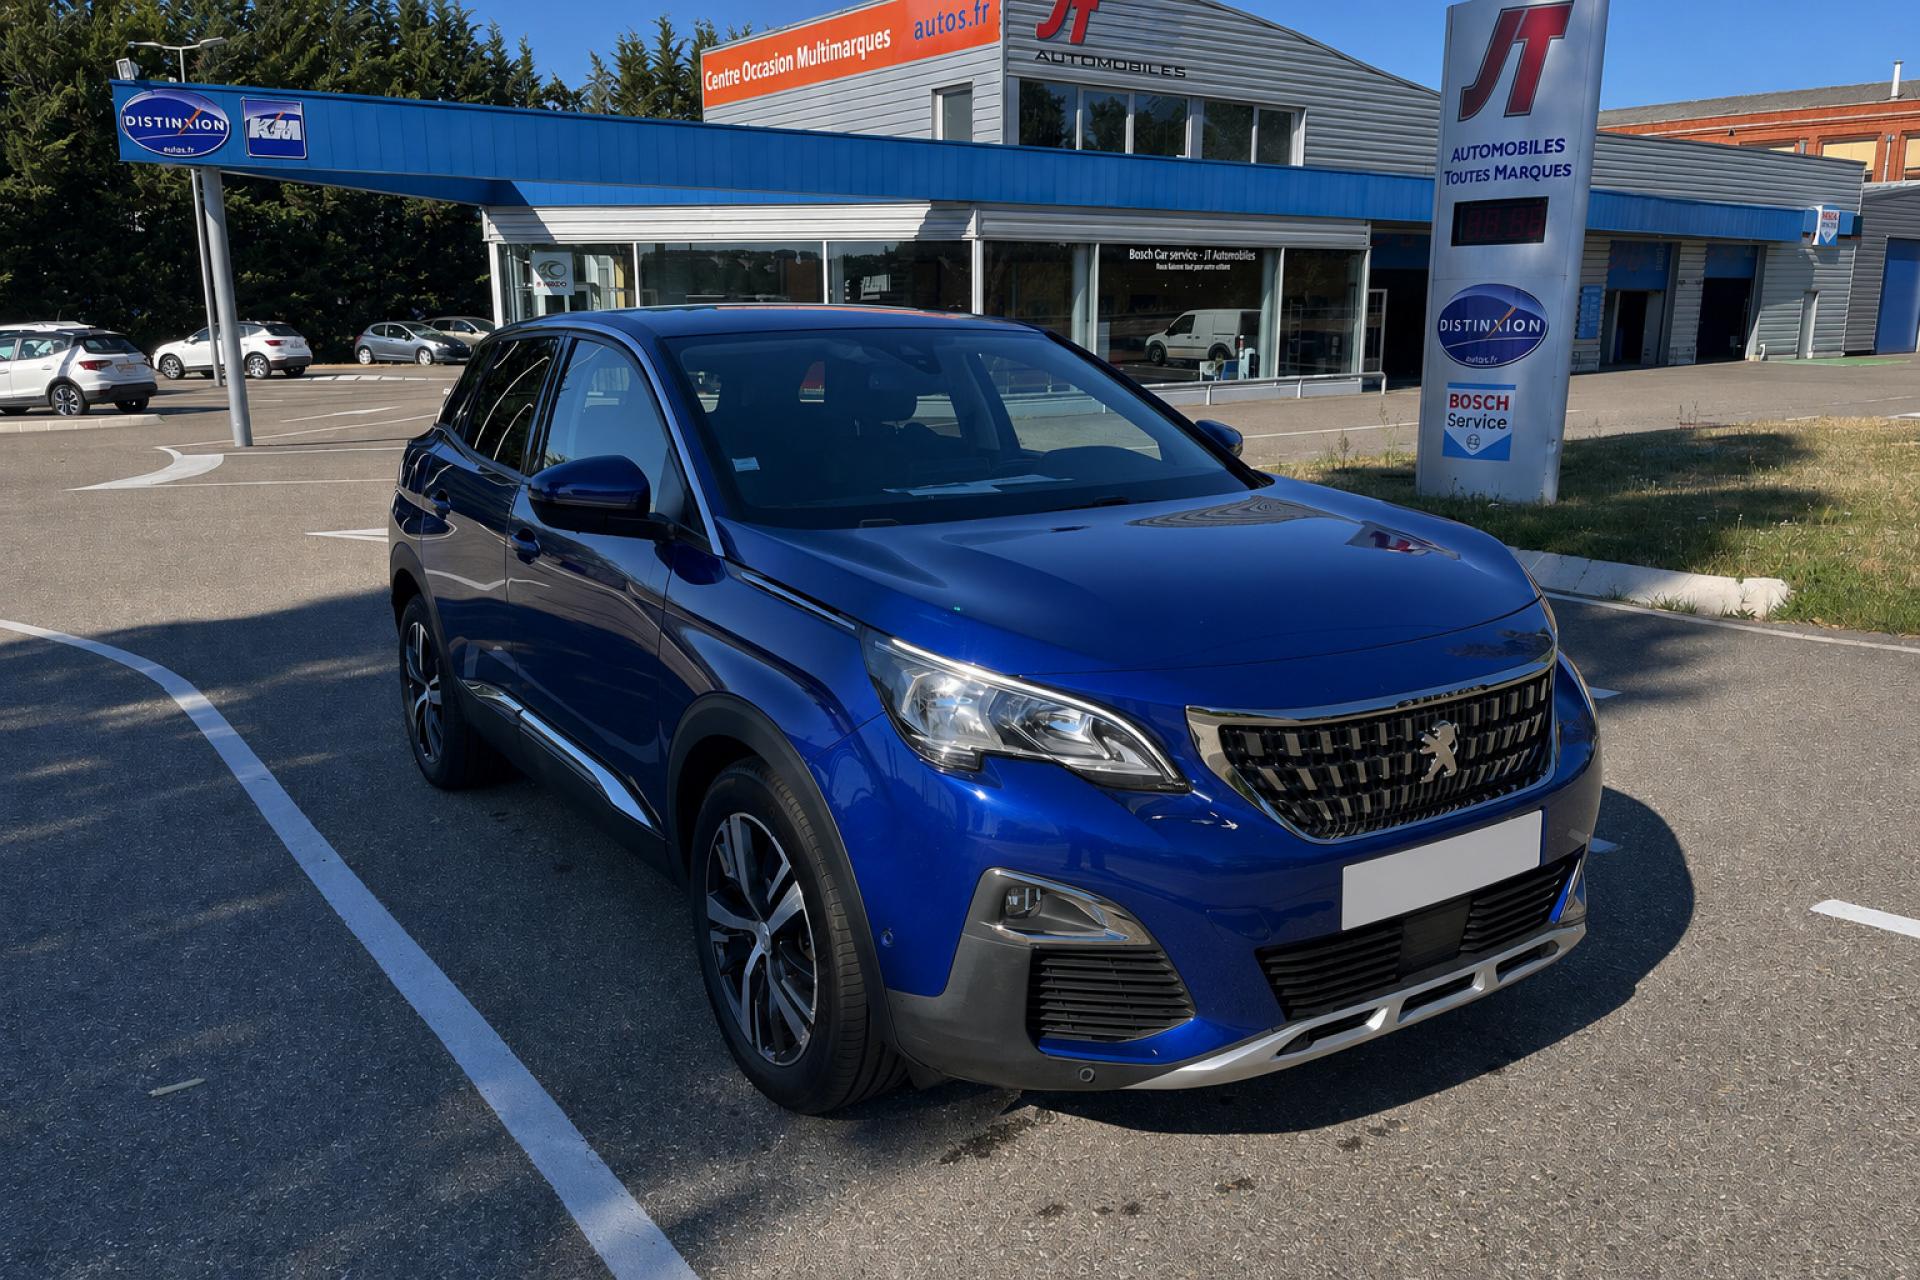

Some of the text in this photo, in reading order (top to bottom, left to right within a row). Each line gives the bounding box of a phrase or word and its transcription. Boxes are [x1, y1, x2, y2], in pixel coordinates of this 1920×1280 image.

[914, 0, 990, 41] autos.fr
[705, 28, 891, 91] Centre Occasion Multimarques
[1035, 50, 1186, 78] AUTOMOBILES
[1458, 1, 1574, 122] JT
[125, 114, 225, 132] DISTINXION
[1451, 138, 1566, 163] AUTOMOBILES
[1129, 248, 1153, 260] Bosch
[1155, 249, 1169, 260] Car
[1169, 249, 1198, 260] service
[1439, 319, 1541, 333] DISTINXION
[1449, 393, 1510, 411] BOSCH
[1447, 412, 1507, 430] Service
